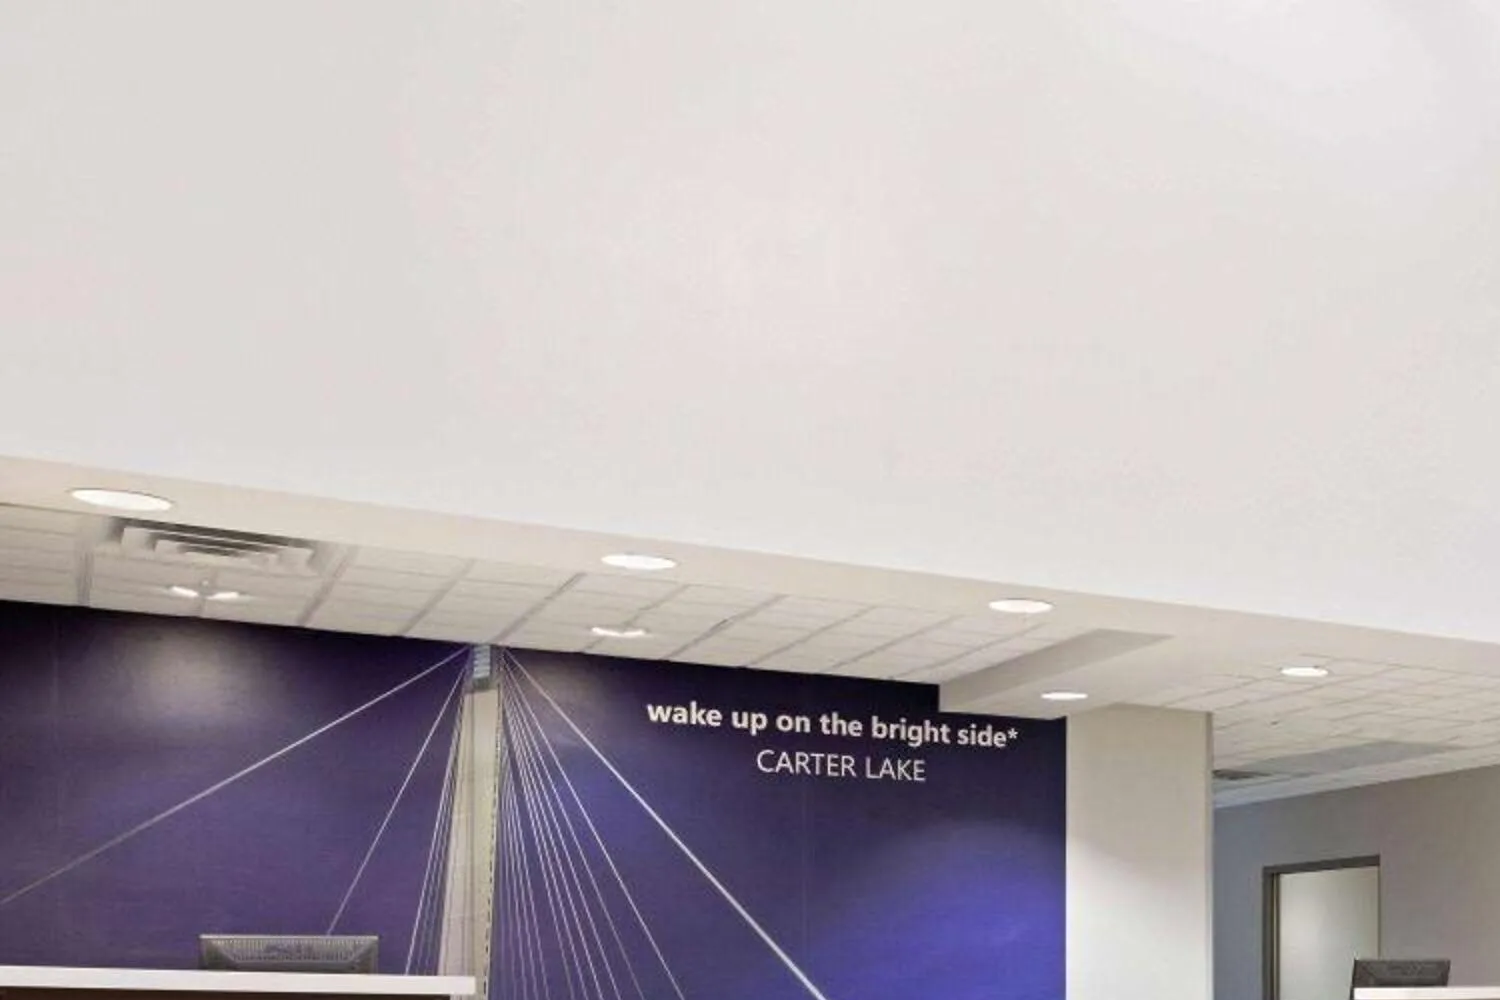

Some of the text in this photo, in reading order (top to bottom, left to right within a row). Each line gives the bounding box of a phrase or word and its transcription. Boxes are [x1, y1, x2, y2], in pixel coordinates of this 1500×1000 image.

[647, 700, 723, 727] wake
[732, 711, 768, 737] up
[776, 714, 811, 733] on
[820, 712, 863, 737] the
[872, 716, 951, 748] bright
[756, 749, 926, 782] CARTER LAKE
